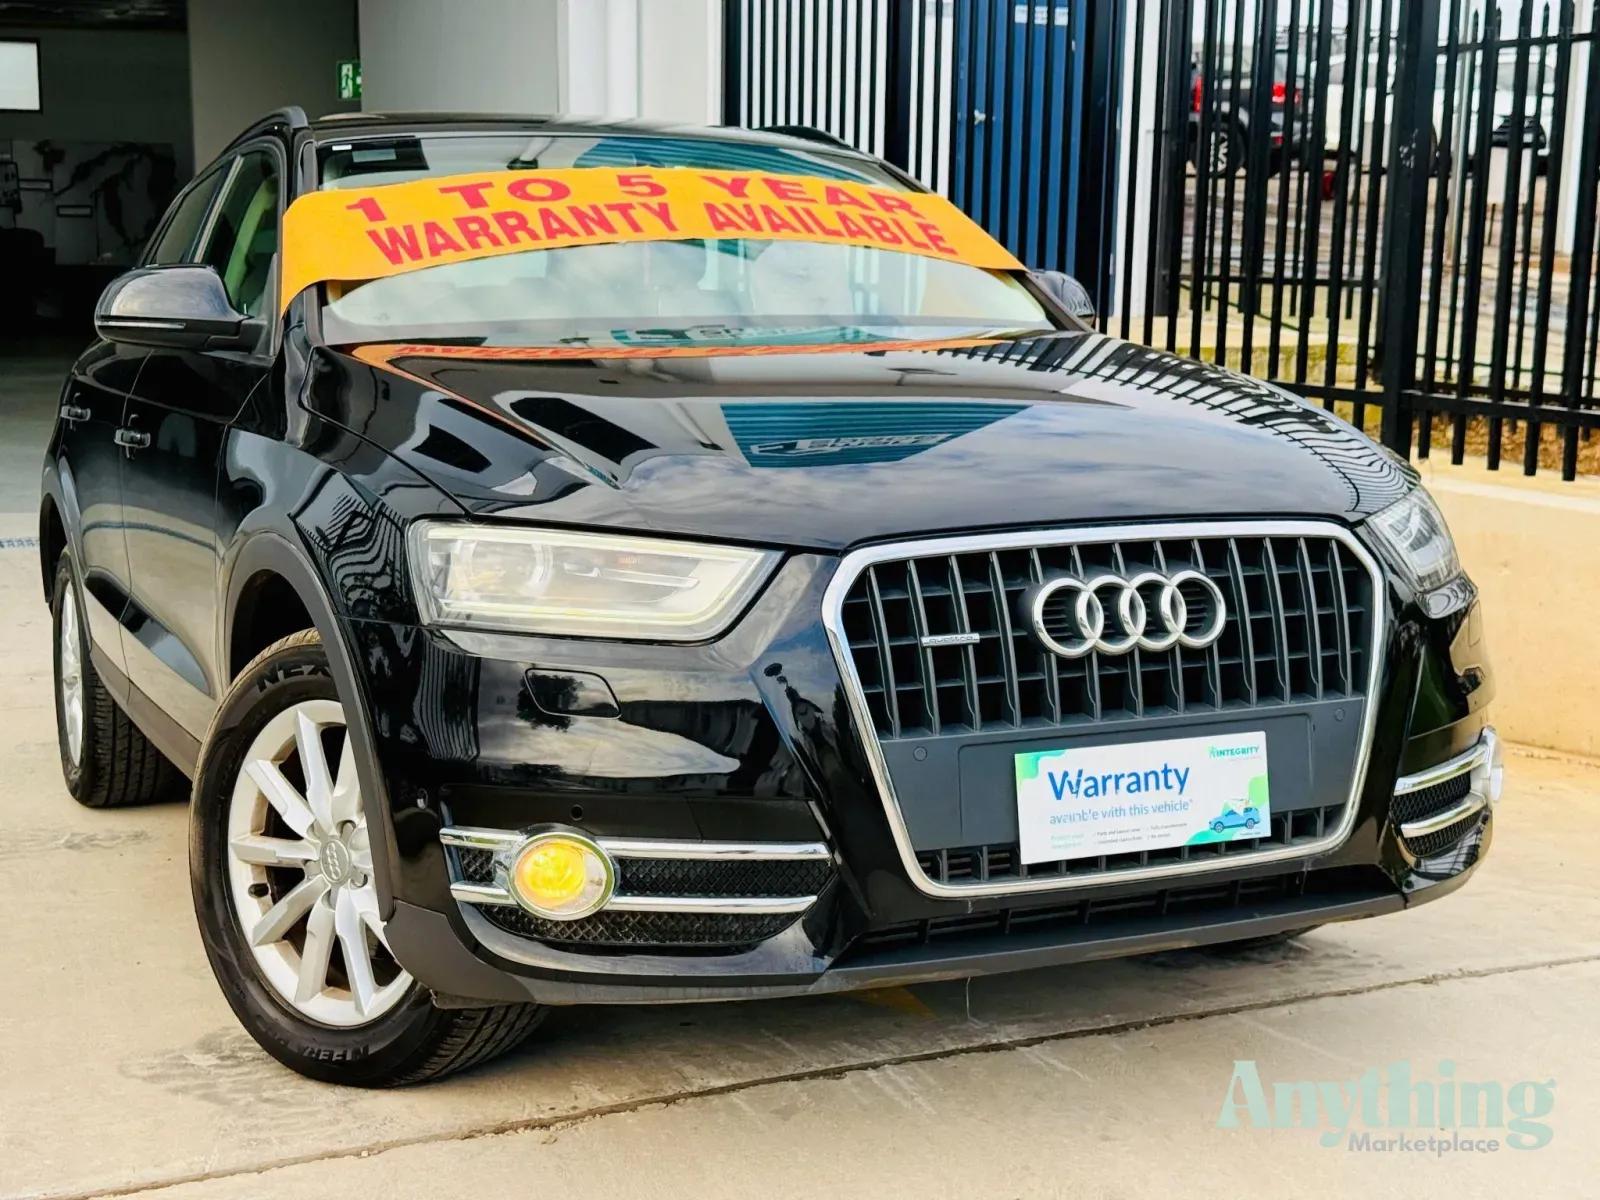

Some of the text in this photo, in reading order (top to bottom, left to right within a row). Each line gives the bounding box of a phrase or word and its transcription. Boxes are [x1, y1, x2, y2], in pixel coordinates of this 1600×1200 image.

[346, 174, 926, 222] 1 TO 5 YEAR
[367, 201, 958, 263] WARRANTY AVAILABLE
[1216, 745, 1260, 757] INTEGRITY
[1047, 763, 1190, 801] Warranty
[1101, 805, 1126, 819] with
[1129, 803, 1149, 816] this
